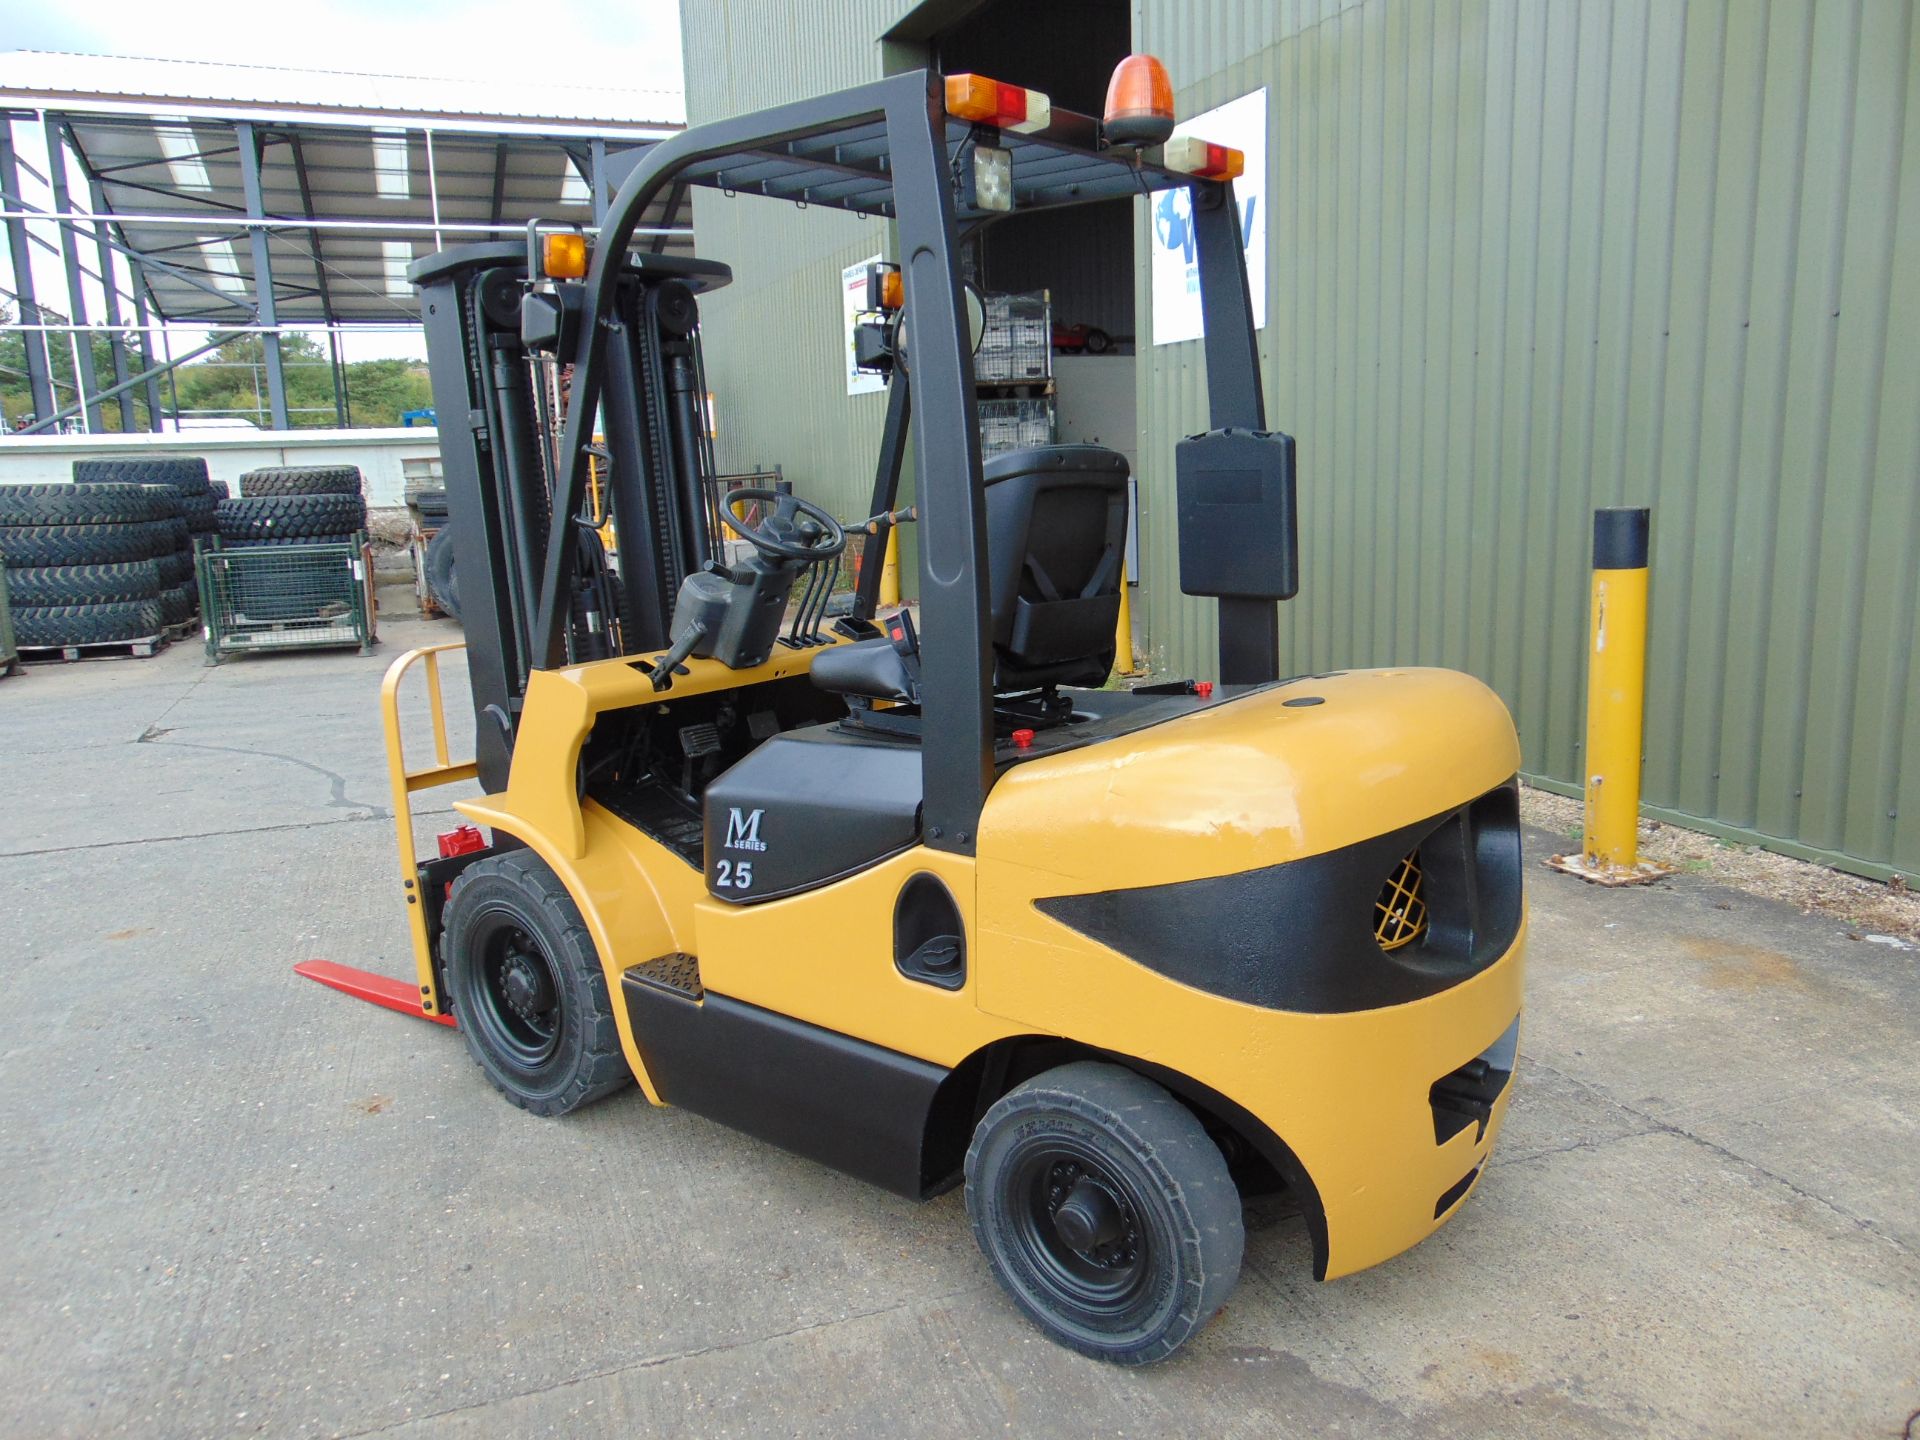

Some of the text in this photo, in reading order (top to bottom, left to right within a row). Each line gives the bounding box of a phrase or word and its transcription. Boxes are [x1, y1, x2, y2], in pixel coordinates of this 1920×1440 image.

[724, 807, 766, 848] M
[734, 840, 768, 852] SERIES
[716, 859, 753, 889] 25
